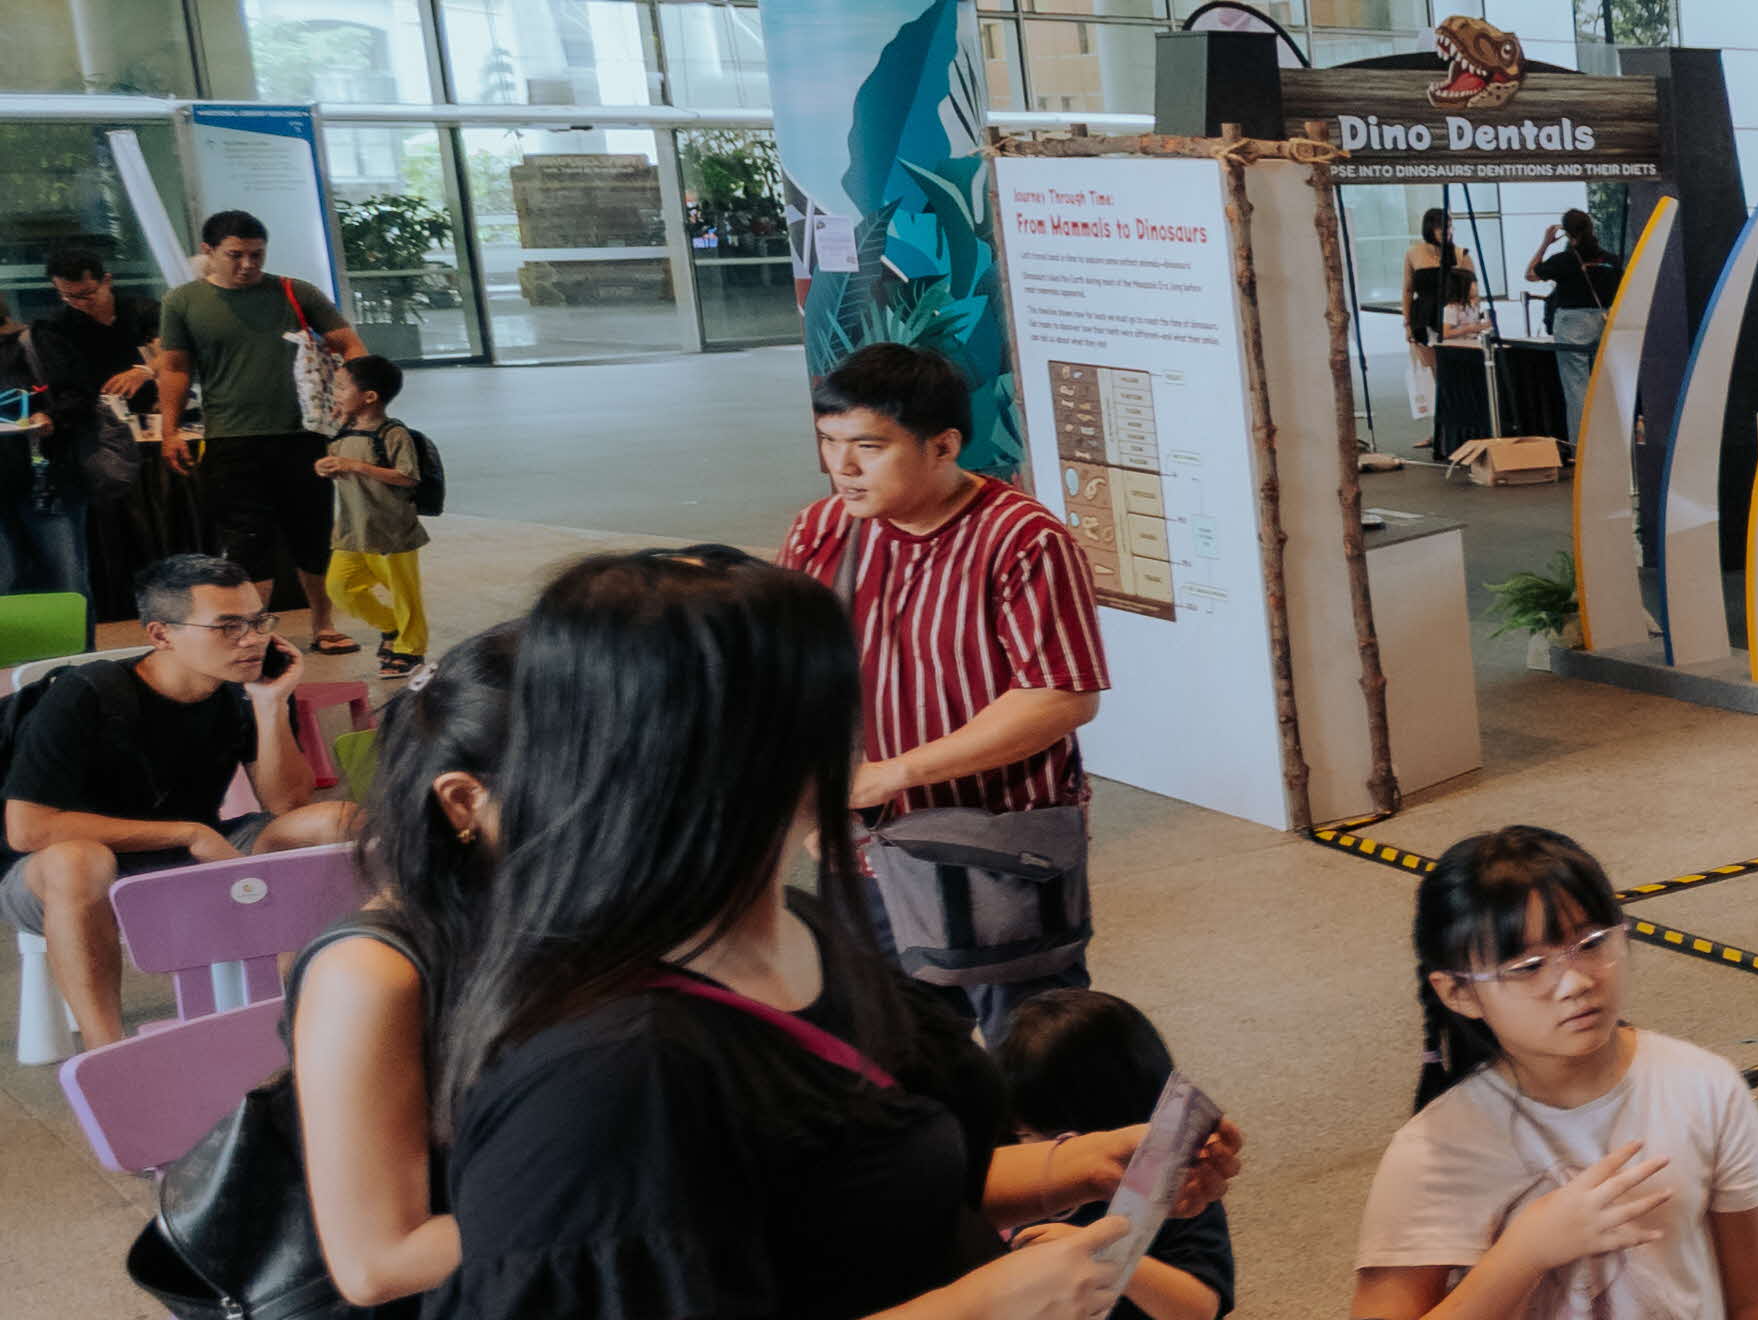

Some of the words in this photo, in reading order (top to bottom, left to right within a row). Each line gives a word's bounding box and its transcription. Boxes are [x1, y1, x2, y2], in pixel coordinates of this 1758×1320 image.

[1338, 114, 1431, 151] Dino
[1446, 115, 1596, 151] Dentals
[1359, 165, 1392, 178] INTO
[1477, 165, 1552, 177] DENTITIONS
[1555, 164, 1582, 176] AND
[1584, 164, 1620, 176] THEIR
[1622, 164, 1656, 176] DIETS
[1048, 188, 1086, 207] Through
[1016, 213, 1046, 234] From
[1050, 215, 1111, 238] Mammals
[1116, 219, 1130, 239] to
[1135, 217, 1208, 244] Dinosaurs
